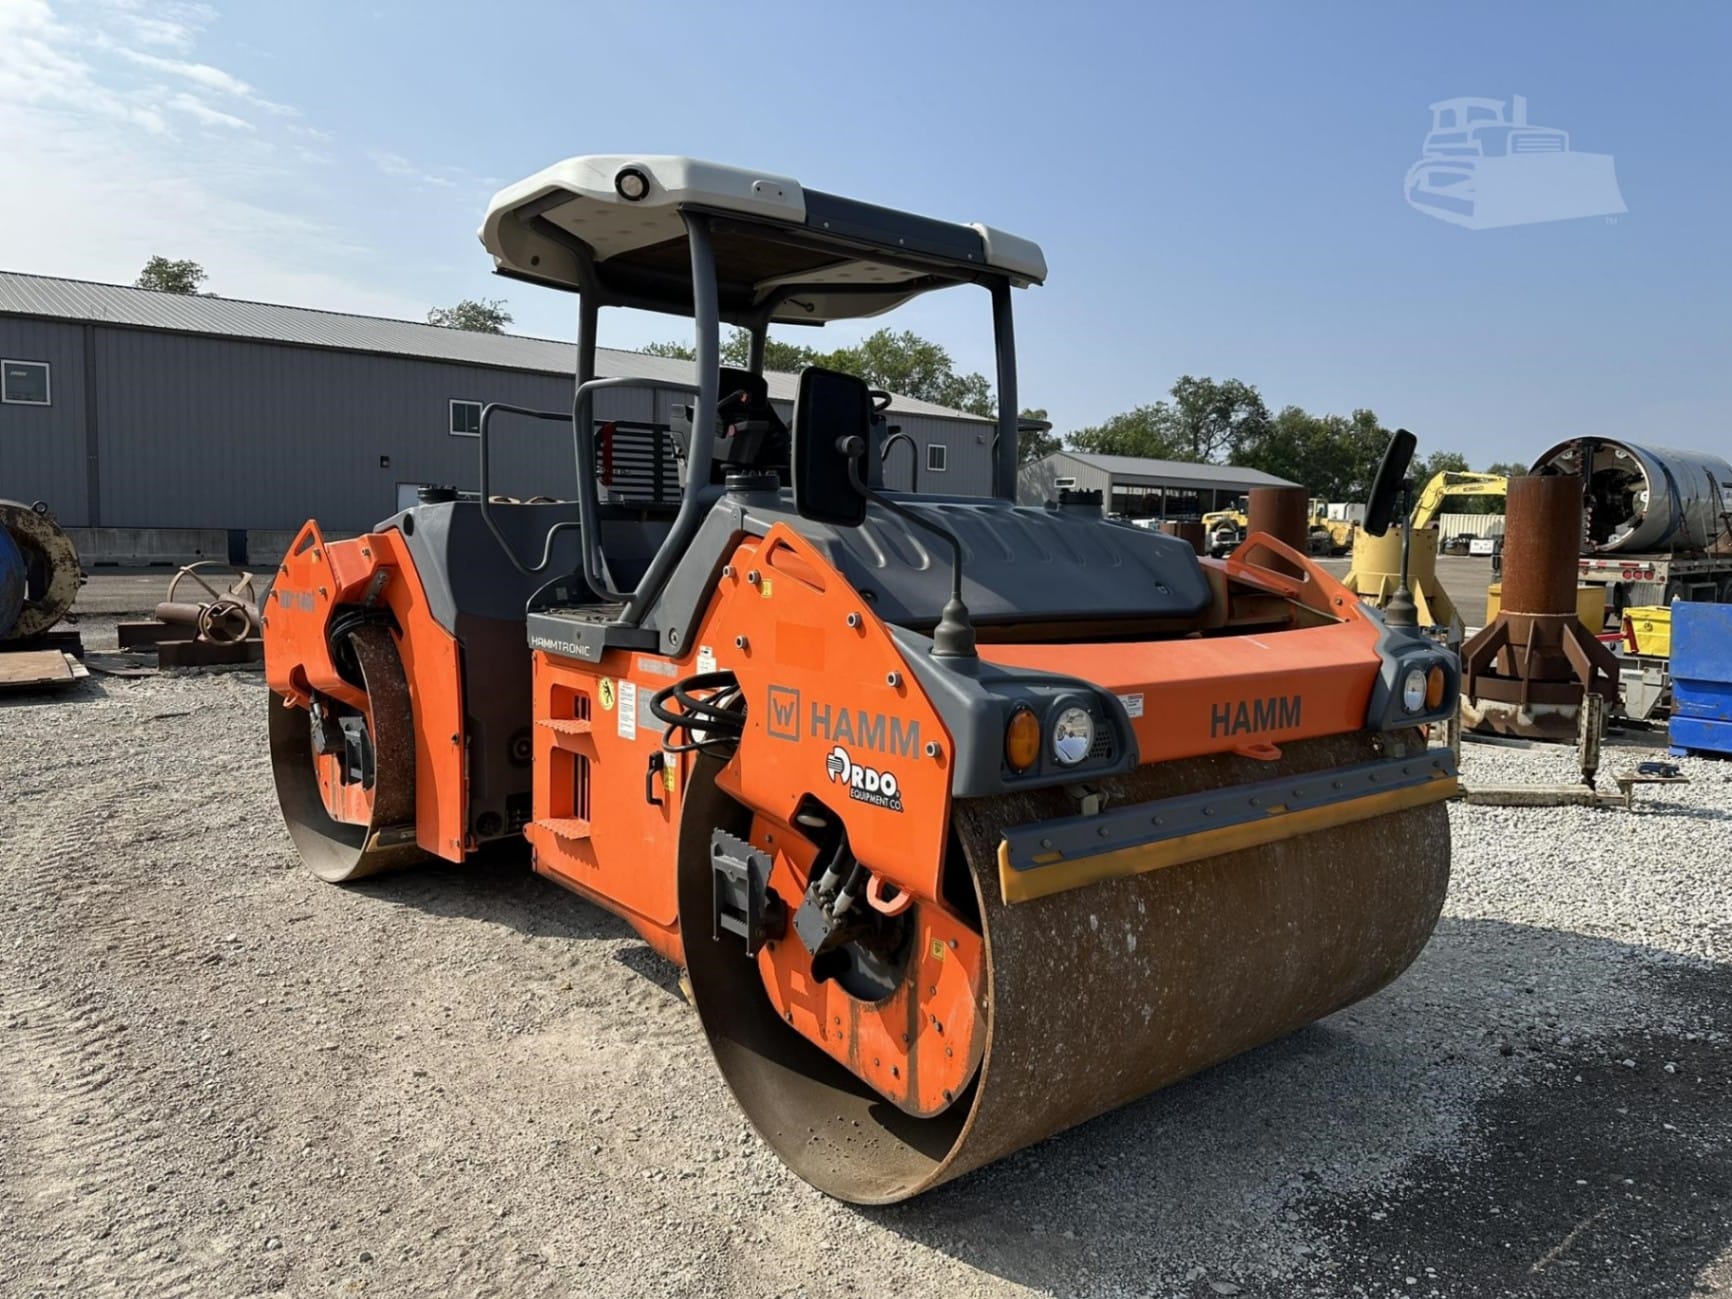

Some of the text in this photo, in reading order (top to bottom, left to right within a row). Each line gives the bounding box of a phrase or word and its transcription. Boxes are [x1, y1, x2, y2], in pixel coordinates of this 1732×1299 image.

[531, 635, 590, 657] HAMMTRONIC
[811, 701, 920, 760] HAMM
[1210, 695, 1302, 738] HAMM
[850, 788, 888, 807] EQUIPMENT
